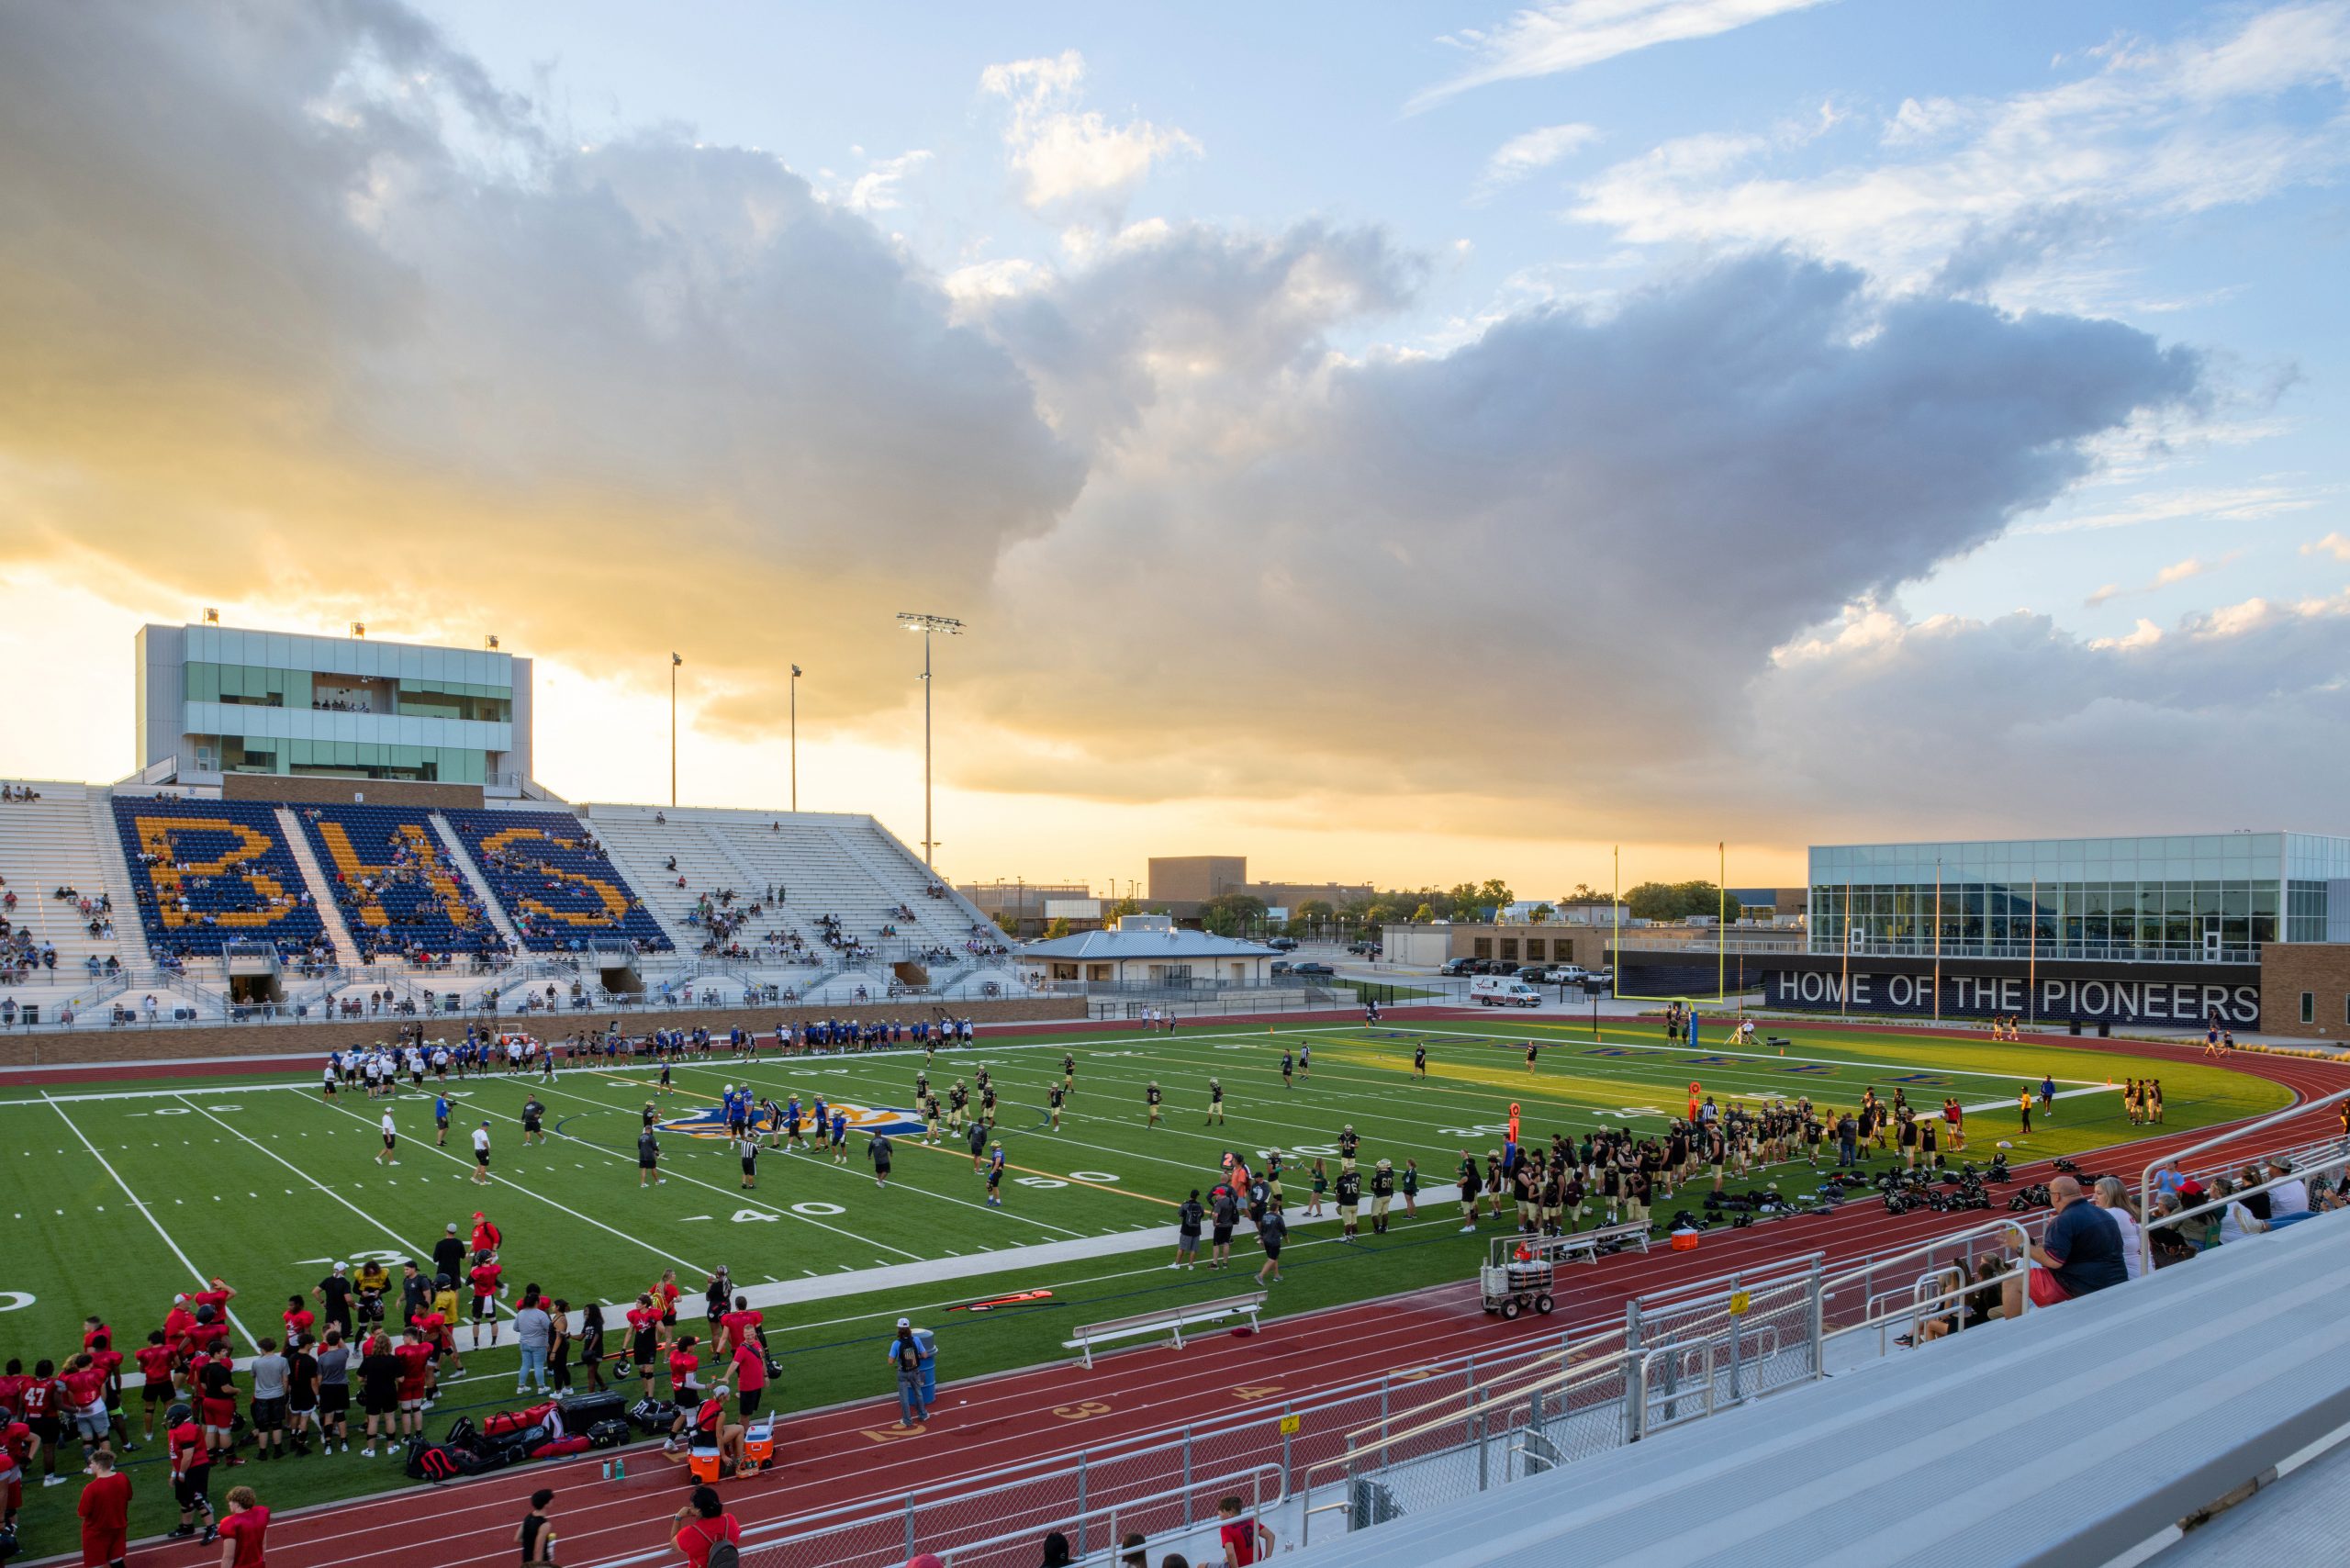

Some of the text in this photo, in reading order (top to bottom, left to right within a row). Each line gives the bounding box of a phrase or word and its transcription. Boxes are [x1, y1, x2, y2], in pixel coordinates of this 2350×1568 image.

[135, 816, 628, 926] BHS
[1780, 971, 2258, 1022] HOME OF THE PIONEERS
[1809, 1126, 1817, 1136] 5
[1223, 1152, 1234, 1167] 2
[1013, 1171, 1121, 1189] 50
[1344, 1182, 1359, 1193] 76
[1381, 1177, 1393, 1189] 60
[731, 1202, 846, 1223] 40
[24, 1387, 46, 1406] 47
[1052, 1402, 1112, 1419] 3
